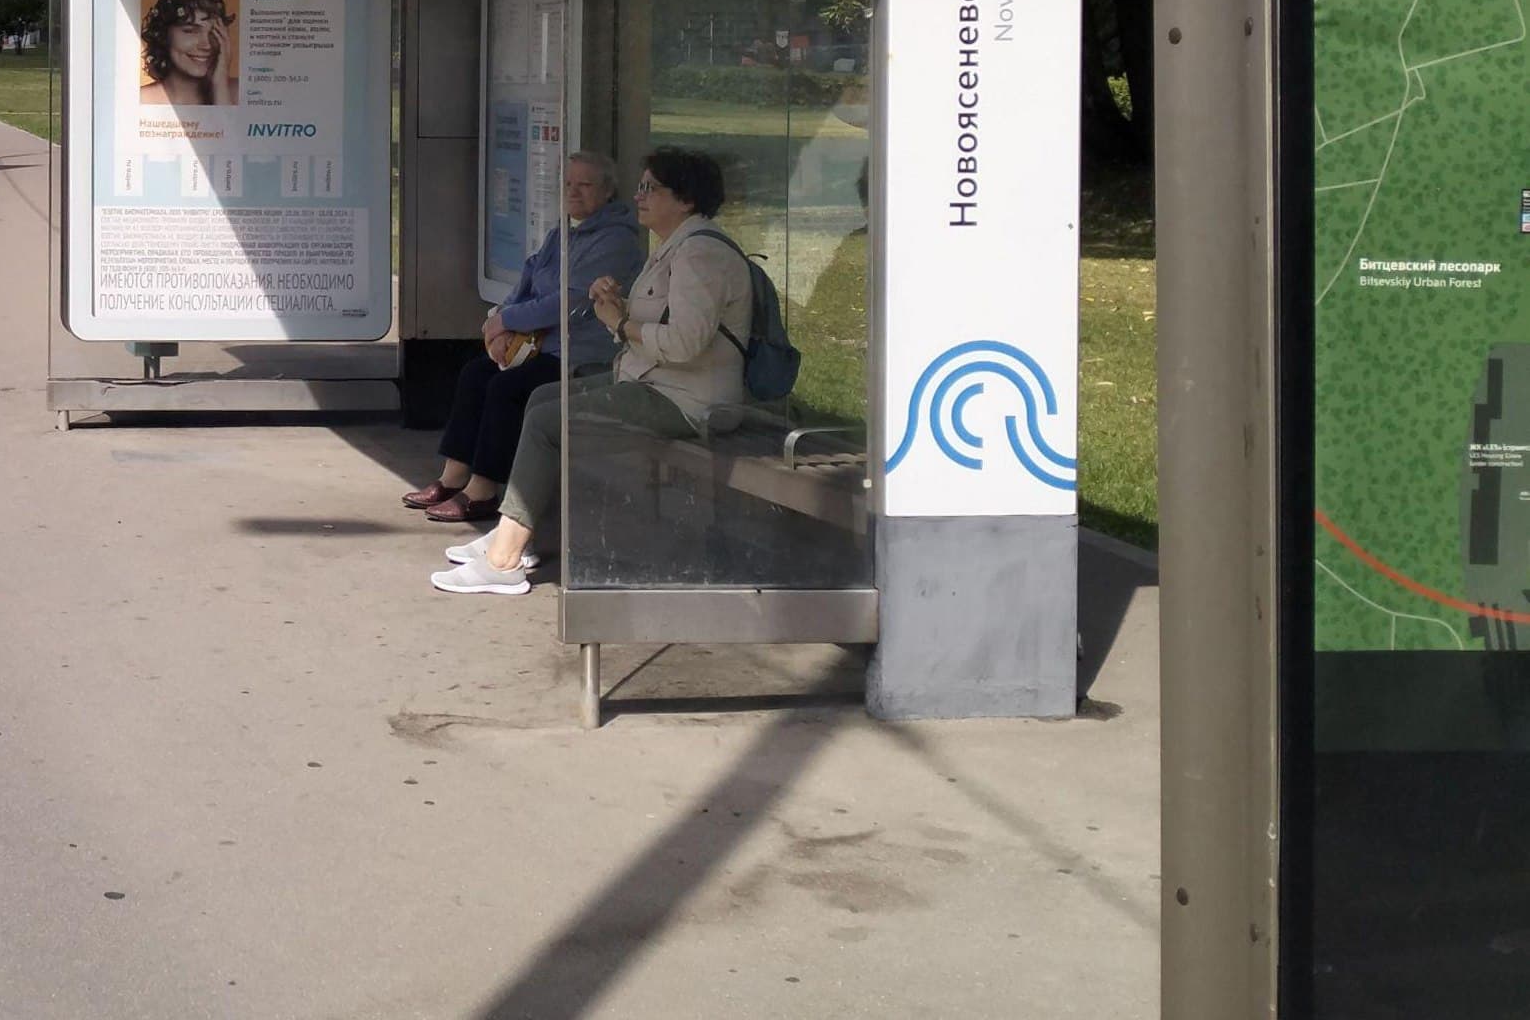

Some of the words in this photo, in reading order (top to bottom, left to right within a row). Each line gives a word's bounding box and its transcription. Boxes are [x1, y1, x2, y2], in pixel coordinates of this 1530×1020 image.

[138, 118, 200, 130] Нашедшему
[247, 123, 317, 138] INVITRO
[138, 129, 225, 139] вознаграждение!
[1358, 257, 1436, 273] Битцевский
[1438, 261, 1502, 276] лесопарк
[100, 272, 154, 289] ИМЕЮТСЯ
[156, 272, 275, 290] ПРОТИВОПОКАЗАНИЯ.
[277, 273, 355, 291] НЕОБХОДИМО
[1359, 275, 1411, 289] Bitsevskiy
[1413, 277, 1446, 288] Urban
[1448, 277, 1482, 289] Forest
[99, 293, 166, 310] ПОЛУЧЕНИЕ
[168, 294, 253, 312] КОНСУЛЬТАЦИИ
[255, 294, 338, 312] СПЕЦИАЛИСТА.
